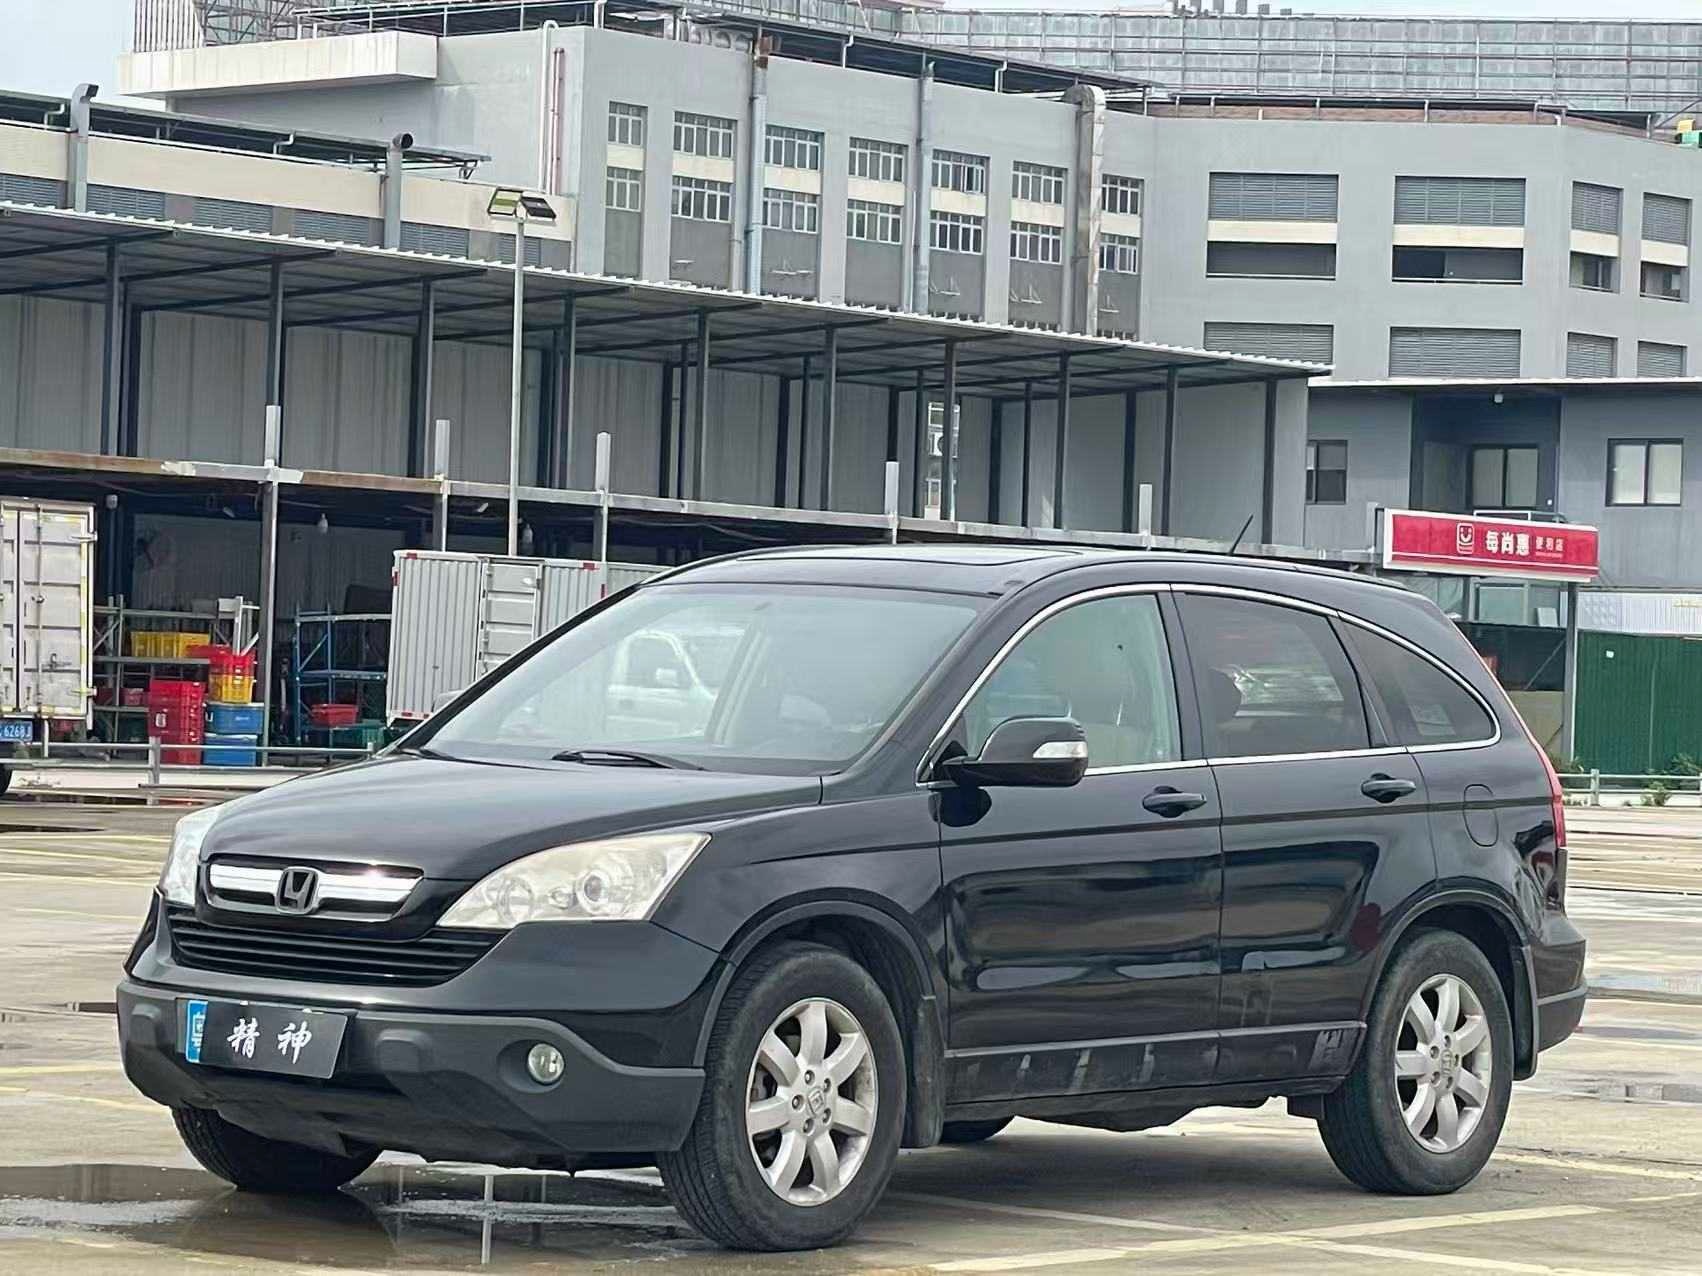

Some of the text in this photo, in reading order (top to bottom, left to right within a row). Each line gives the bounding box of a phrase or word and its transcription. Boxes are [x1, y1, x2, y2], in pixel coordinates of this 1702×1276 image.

[1486, 530, 1530, 556] 每尚惠
[227, 1017, 312, 1064] 精神
